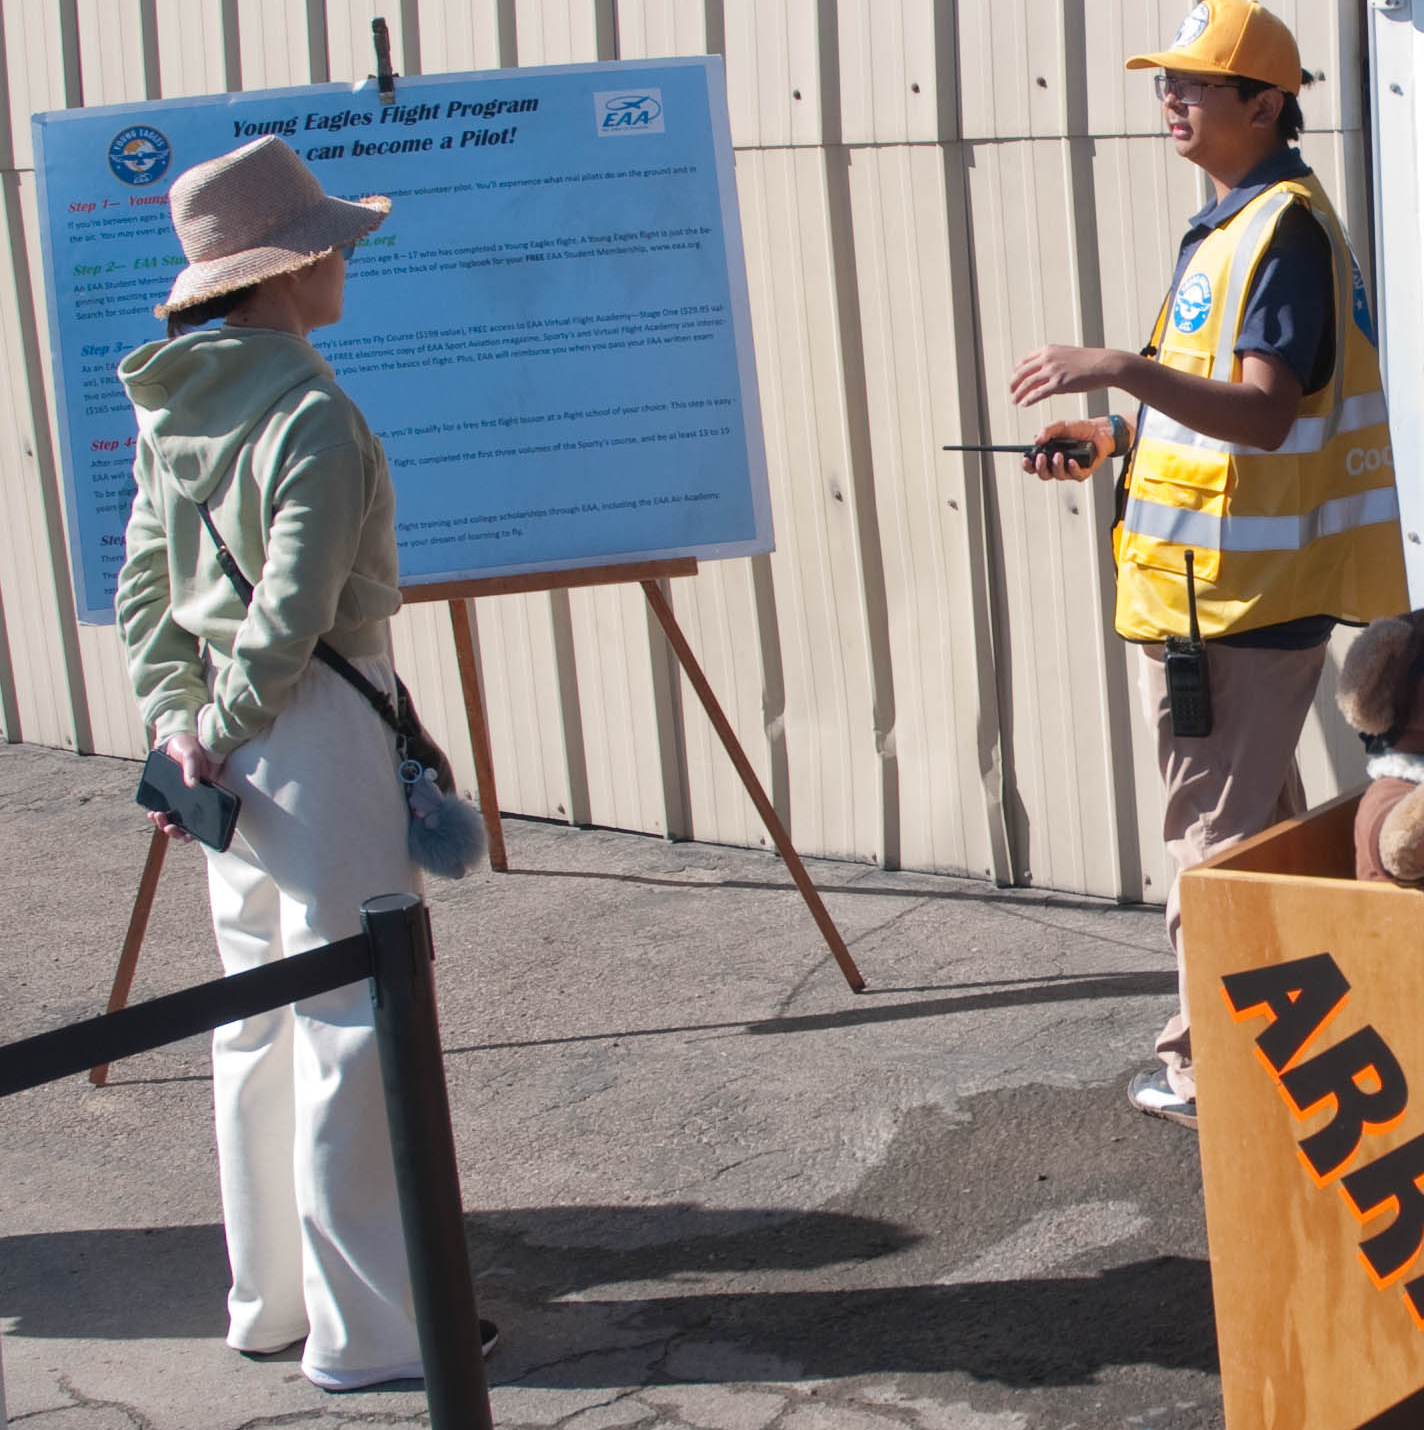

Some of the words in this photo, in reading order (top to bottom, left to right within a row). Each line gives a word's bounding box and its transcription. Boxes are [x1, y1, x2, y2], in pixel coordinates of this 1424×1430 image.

[232, 119, 300, 137] Young
[302, 109, 374, 132] Eagles
[378, 102, 442, 126] Flight
[444, 98, 540, 119] Program
[601, 109, 650, 128] EAA
[305, 144, 345, 161] can
[350, 138, 434, 157] become
[438, 135, 454, 149] a
[458, 126, 519, 148] Pilot!
[67, 202, 96, 213] Step
[73, 263, 102, 275] Step
[133, 256, 158, 268] EAA
[80, 344, 110, 356] Step
[90, 439, 120, 451] Step
